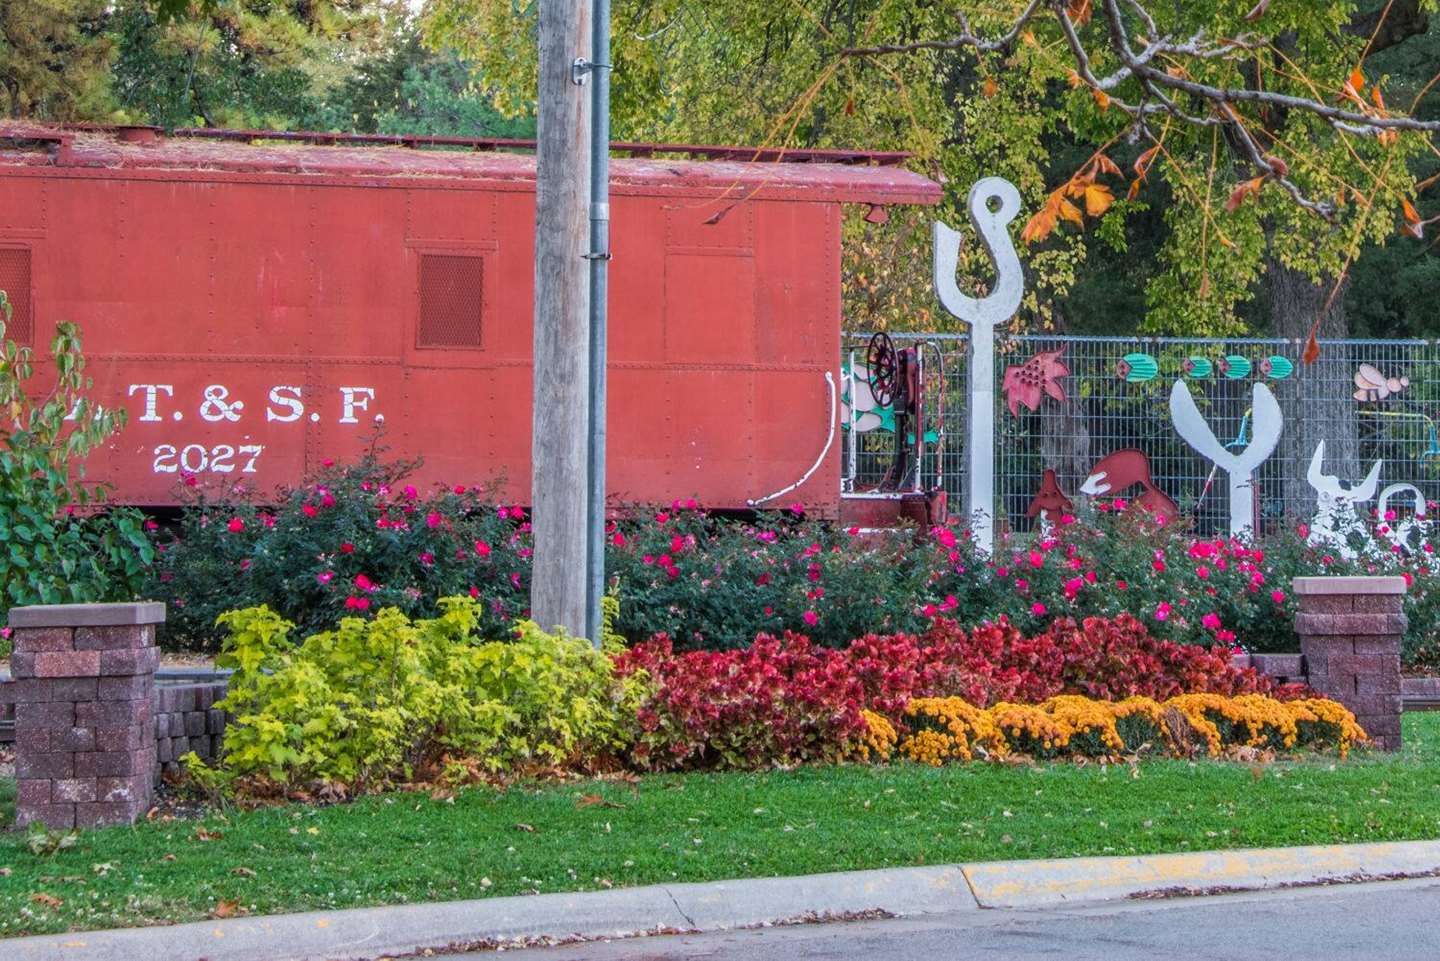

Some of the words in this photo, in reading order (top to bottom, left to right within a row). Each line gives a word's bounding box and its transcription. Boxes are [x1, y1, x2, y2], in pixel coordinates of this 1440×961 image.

[128, 384, 183, 421] T.
[199, 384, 244, 422] &
[266, 385, 320, 422] S.
[338, 386, 385, 423] F.
[153, 444, 264, 473] 2027
